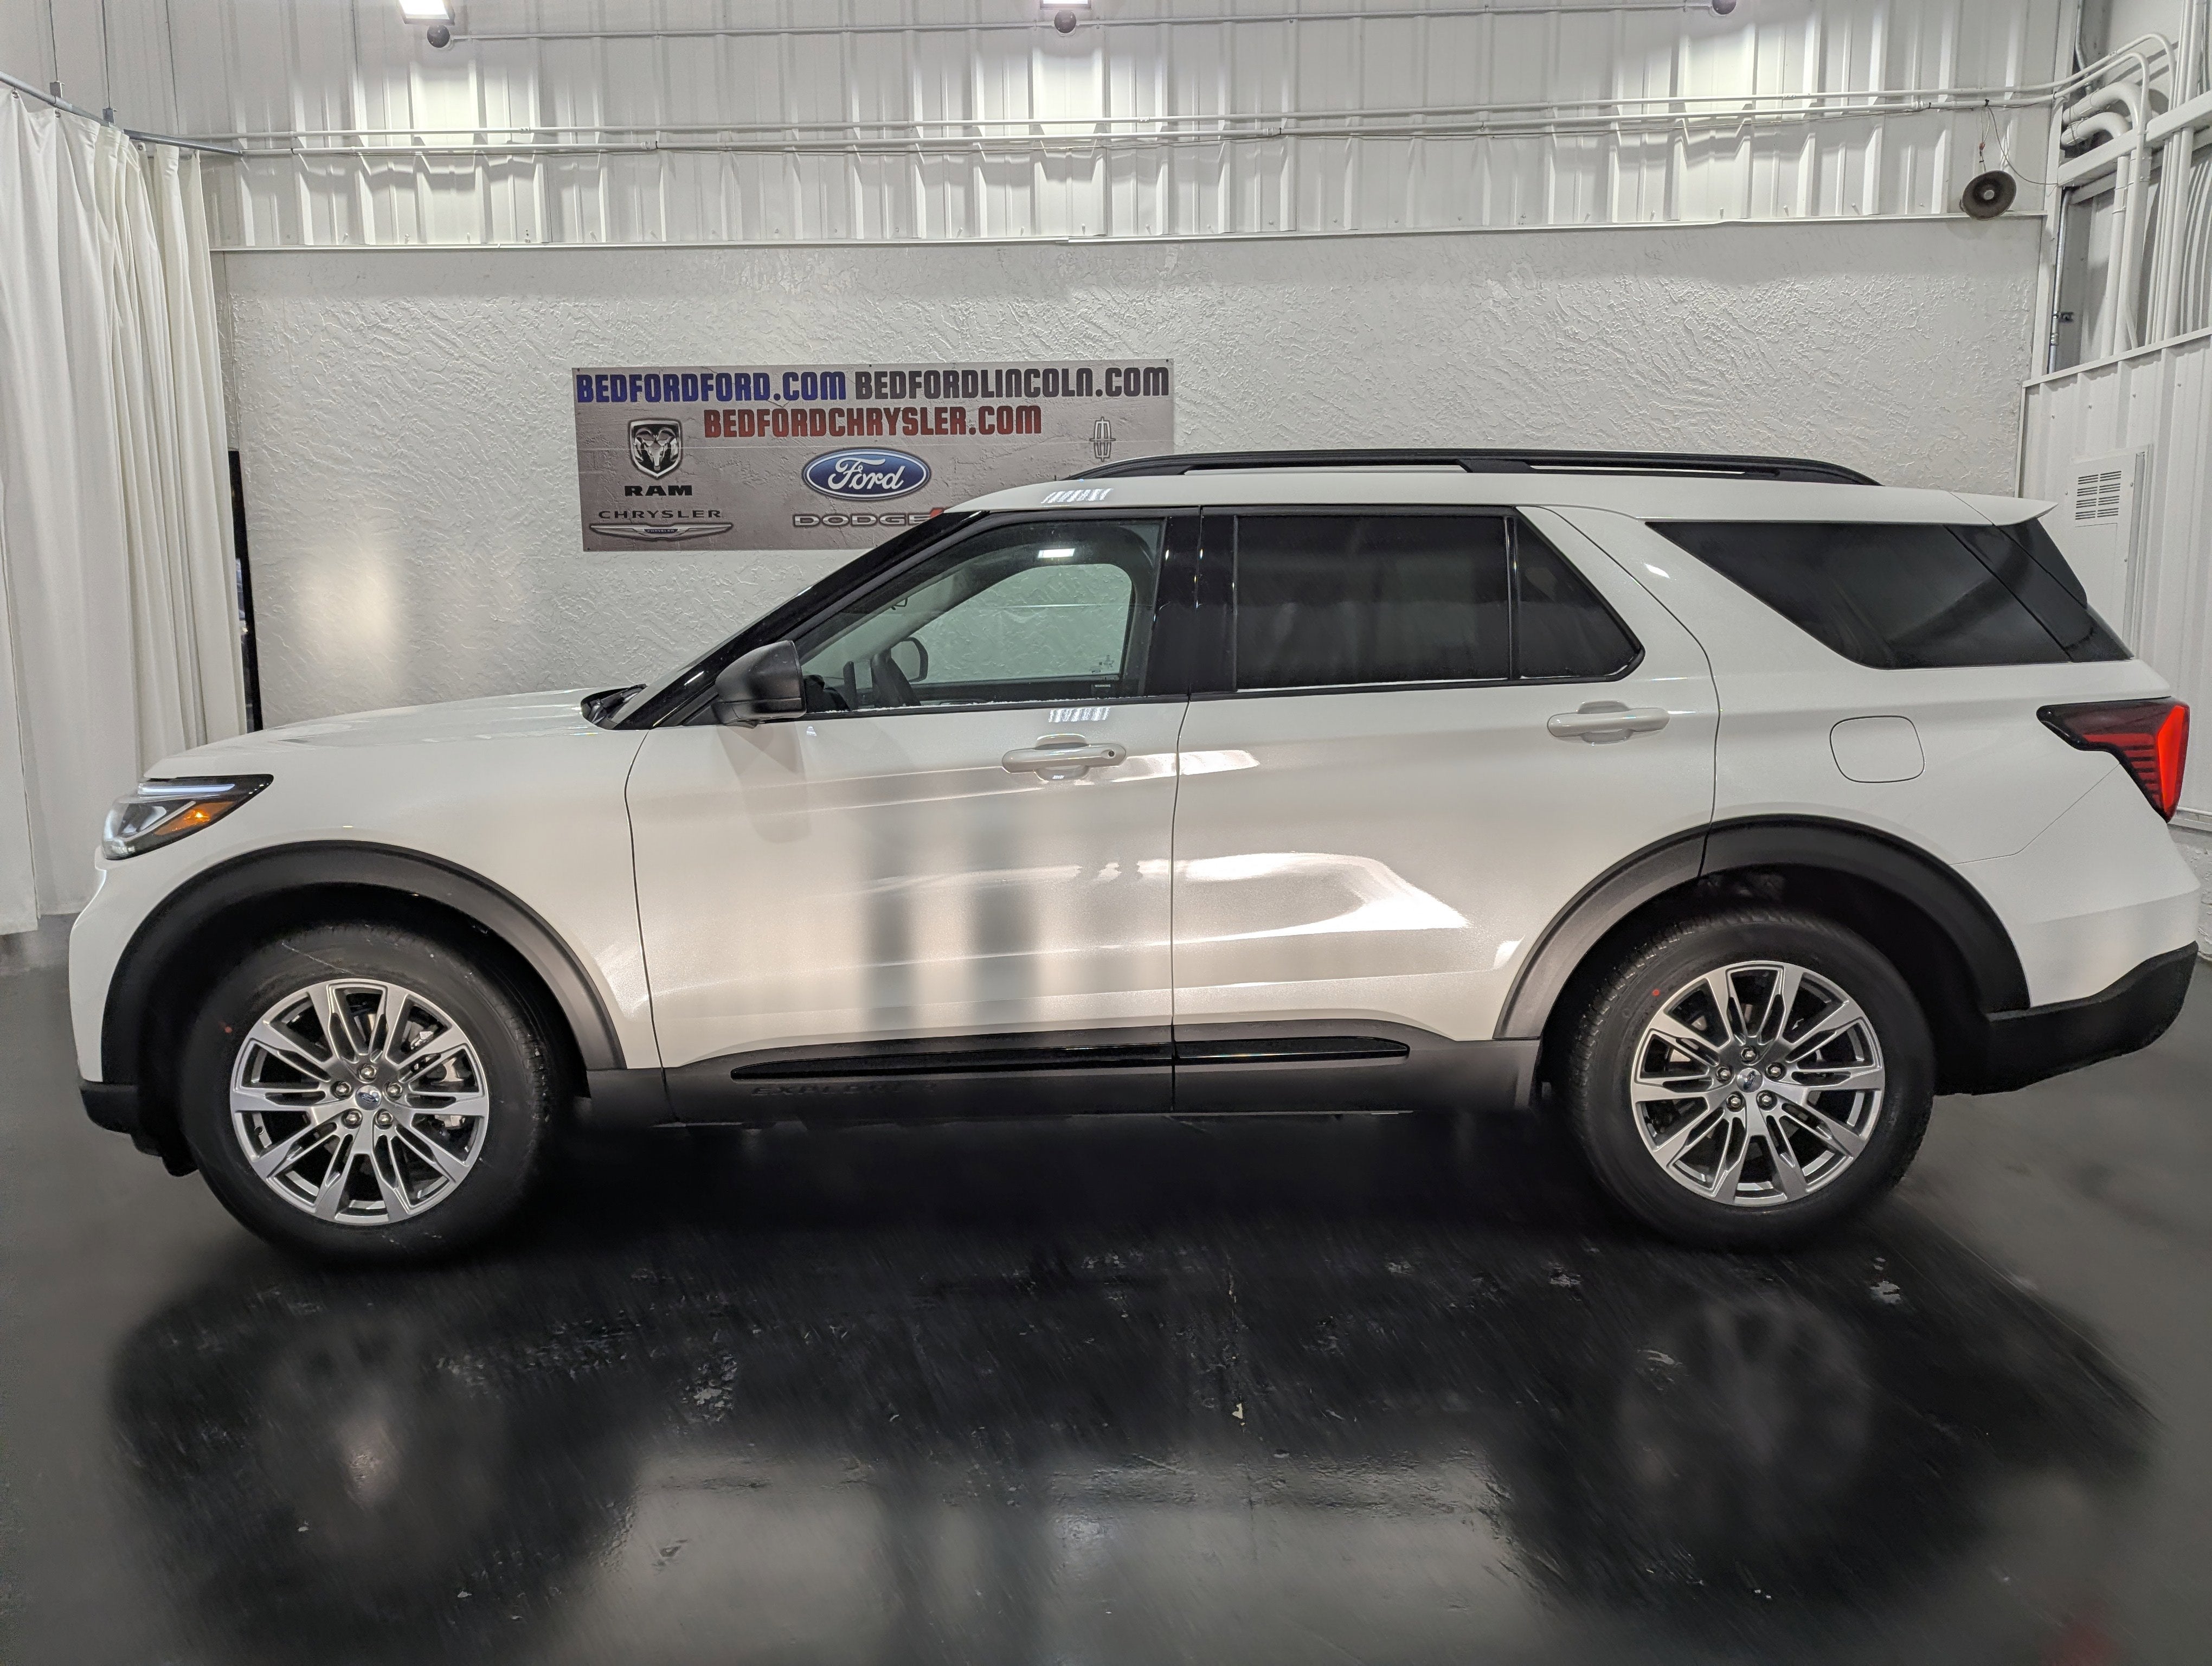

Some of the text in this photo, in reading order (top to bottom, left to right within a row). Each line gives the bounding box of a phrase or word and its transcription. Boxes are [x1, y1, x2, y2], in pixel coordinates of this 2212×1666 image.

[577, 367, 1169, 402] BEDFORDFORD.COM BEDFORDLINCOLN.COM
[704, 405, 1042, 438] BEDFORDCHRYSLER.COM
[827, 457, 905, 490] Ford
[625, 485, 693, 496] RAM
[598, 510, 722, 519] CHRYSLER
[793, 514, 931, 527] DODGE
